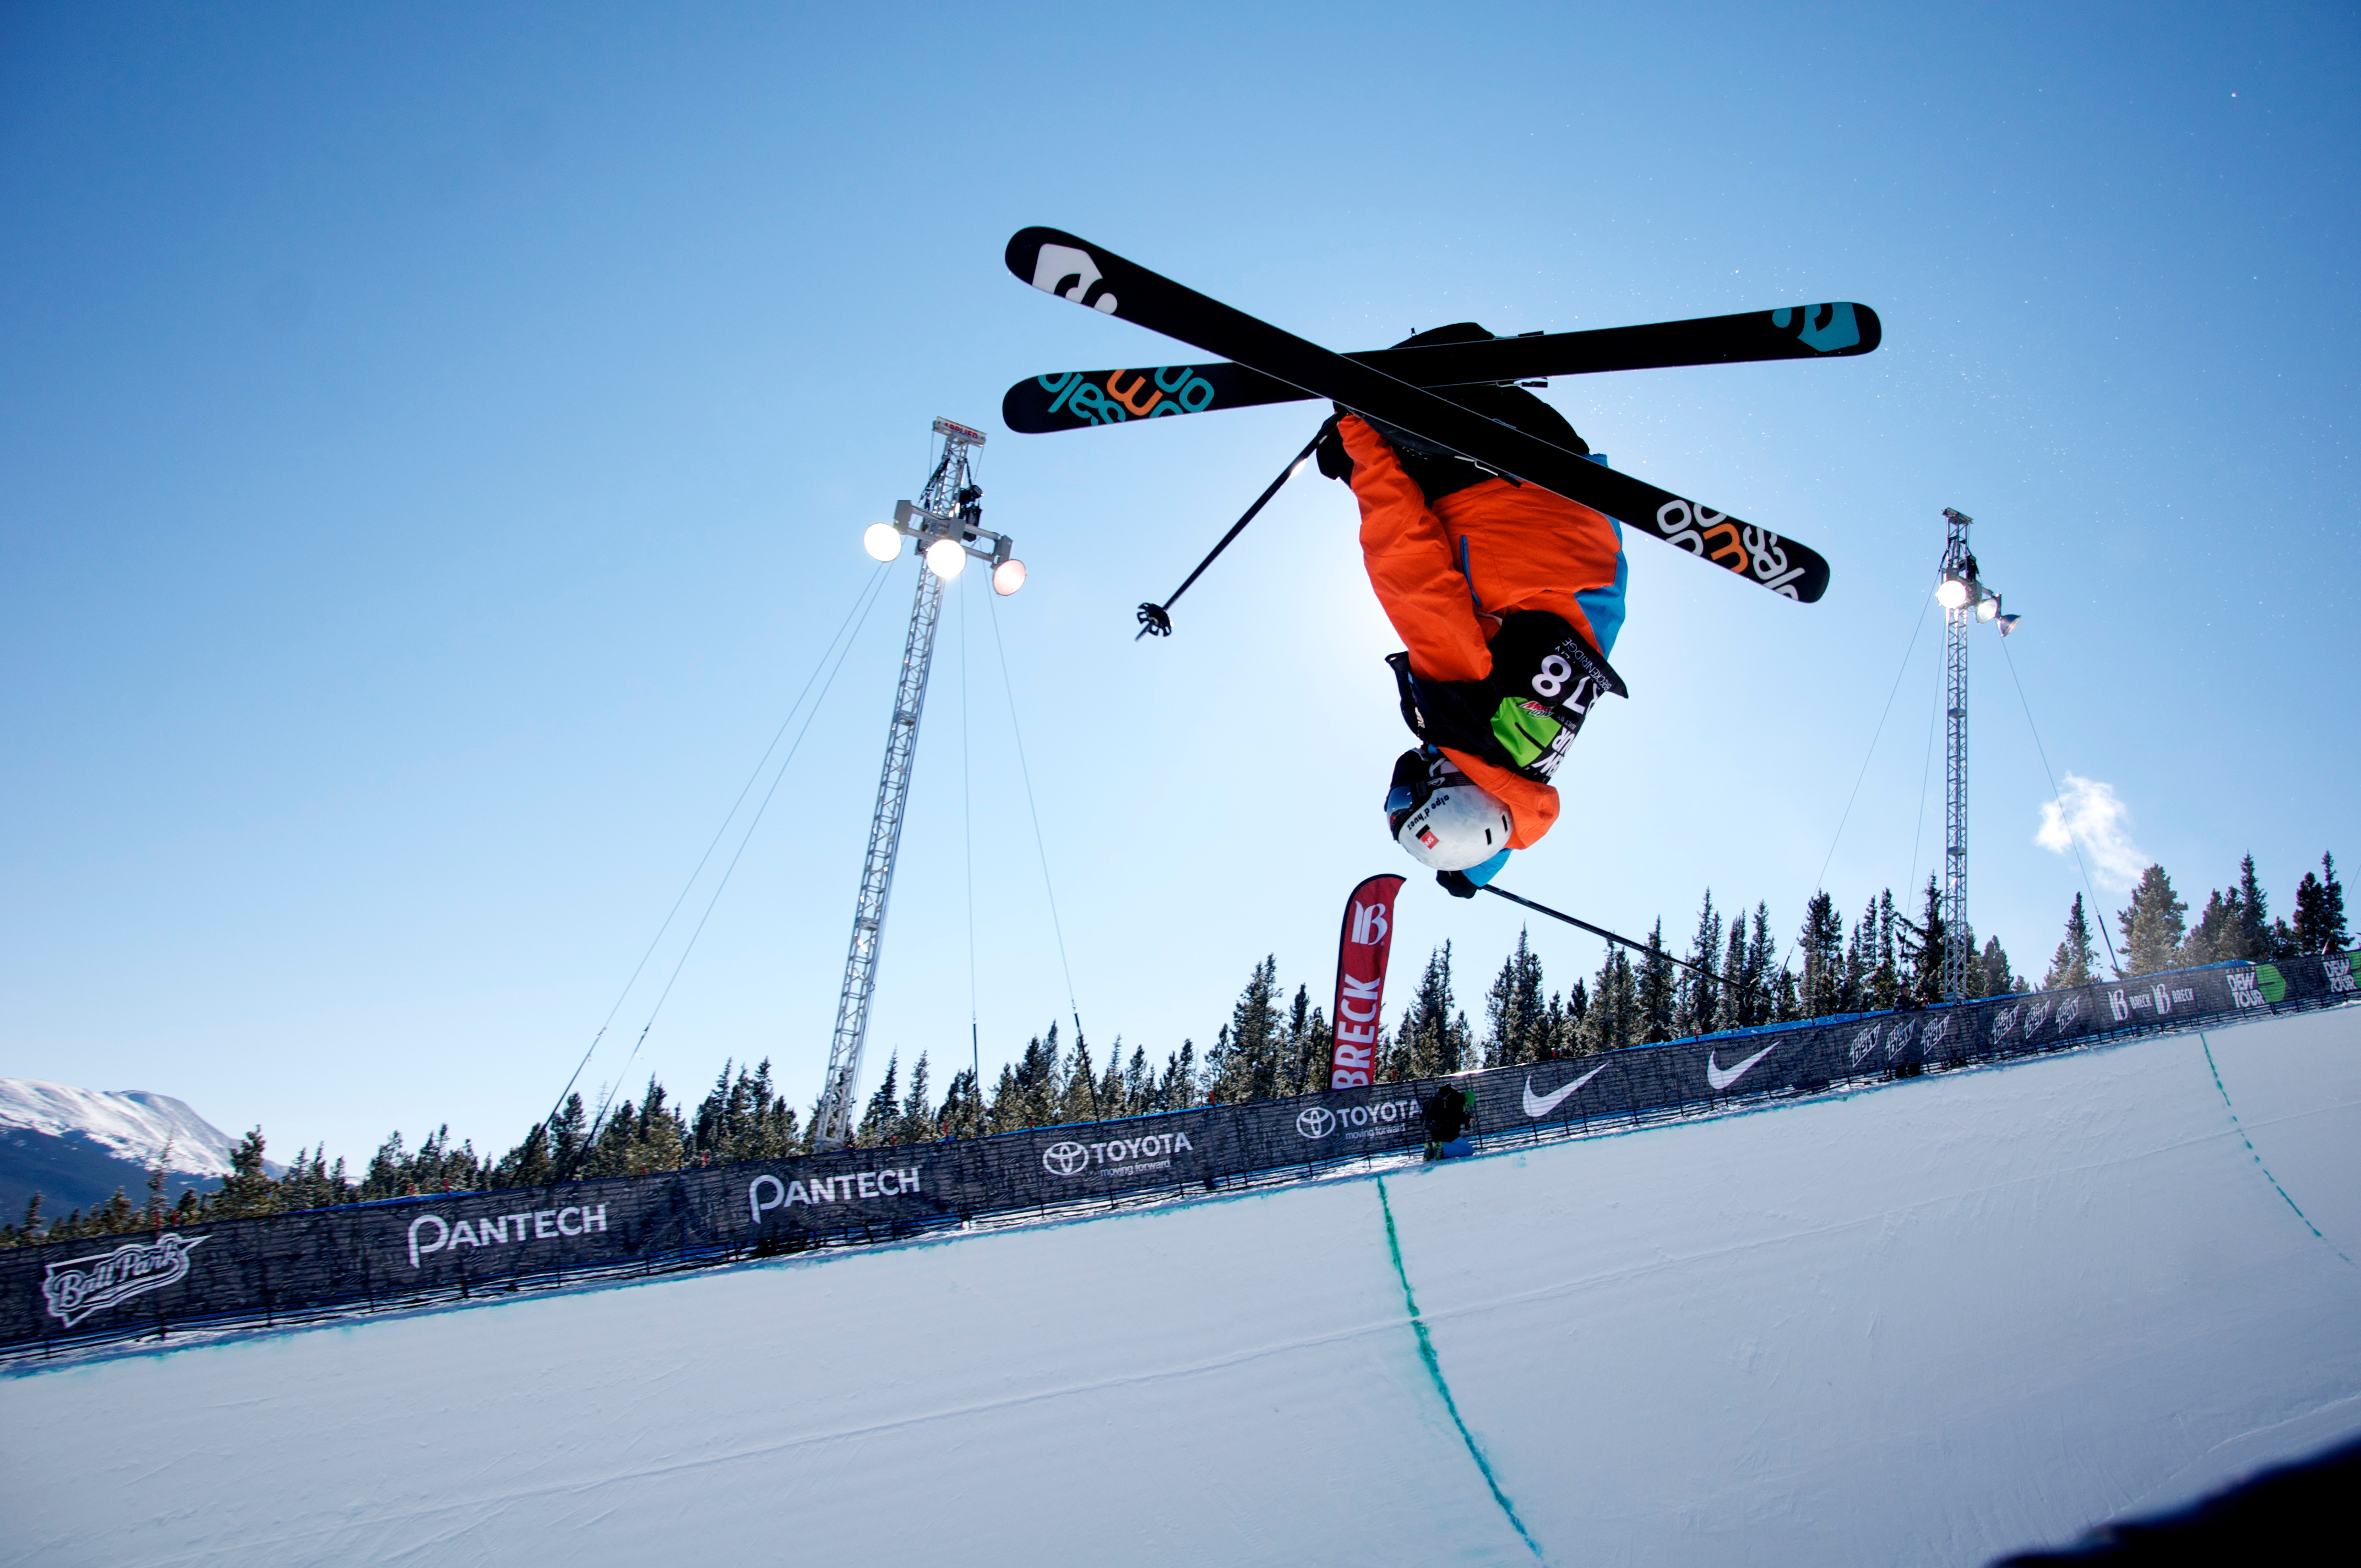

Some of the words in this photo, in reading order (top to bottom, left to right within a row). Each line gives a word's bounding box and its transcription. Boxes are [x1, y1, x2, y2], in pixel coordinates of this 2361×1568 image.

[1562, 638, 1612, 691] BRECKENRIDGE
[1531, 655, 1600, 715] 78
[1531, 752, 1564, 778] EW
[1431, 794, 1450, 809] alpe
[1407, 808, 1430, 831] d'huez
[2322, 959, 2351, 977] DEW
[2226, 972, 2256, 992] DEW
[2329, 975, 2358, 993] TOUR
[2129, 994, 2152, 1009] BRECK
[2172, 988, 2194, 1003] BRECK
[2232, 989, 2266, 1008] TOUR
[1331, 973, 1380, 1089] BRECK
[1336, 1099, 1422, 1128] TOYOTA
[1345, 1129, 1374, 1140] moving
[1375, 1124, 1406, 1135] forward
[1090, 1132, 1193, 1164] TOYOTA
[1100, 1164, 1134, 1177] moving
[1134, 1158, 1171, 1172] forward
[749, 1167, 920, 1224] PANTECH
[408, 1204, 607, 1268] PANTECH
[55, 1262, 117, 1308] Ball
[115, 1241, 179, 1283] Park
